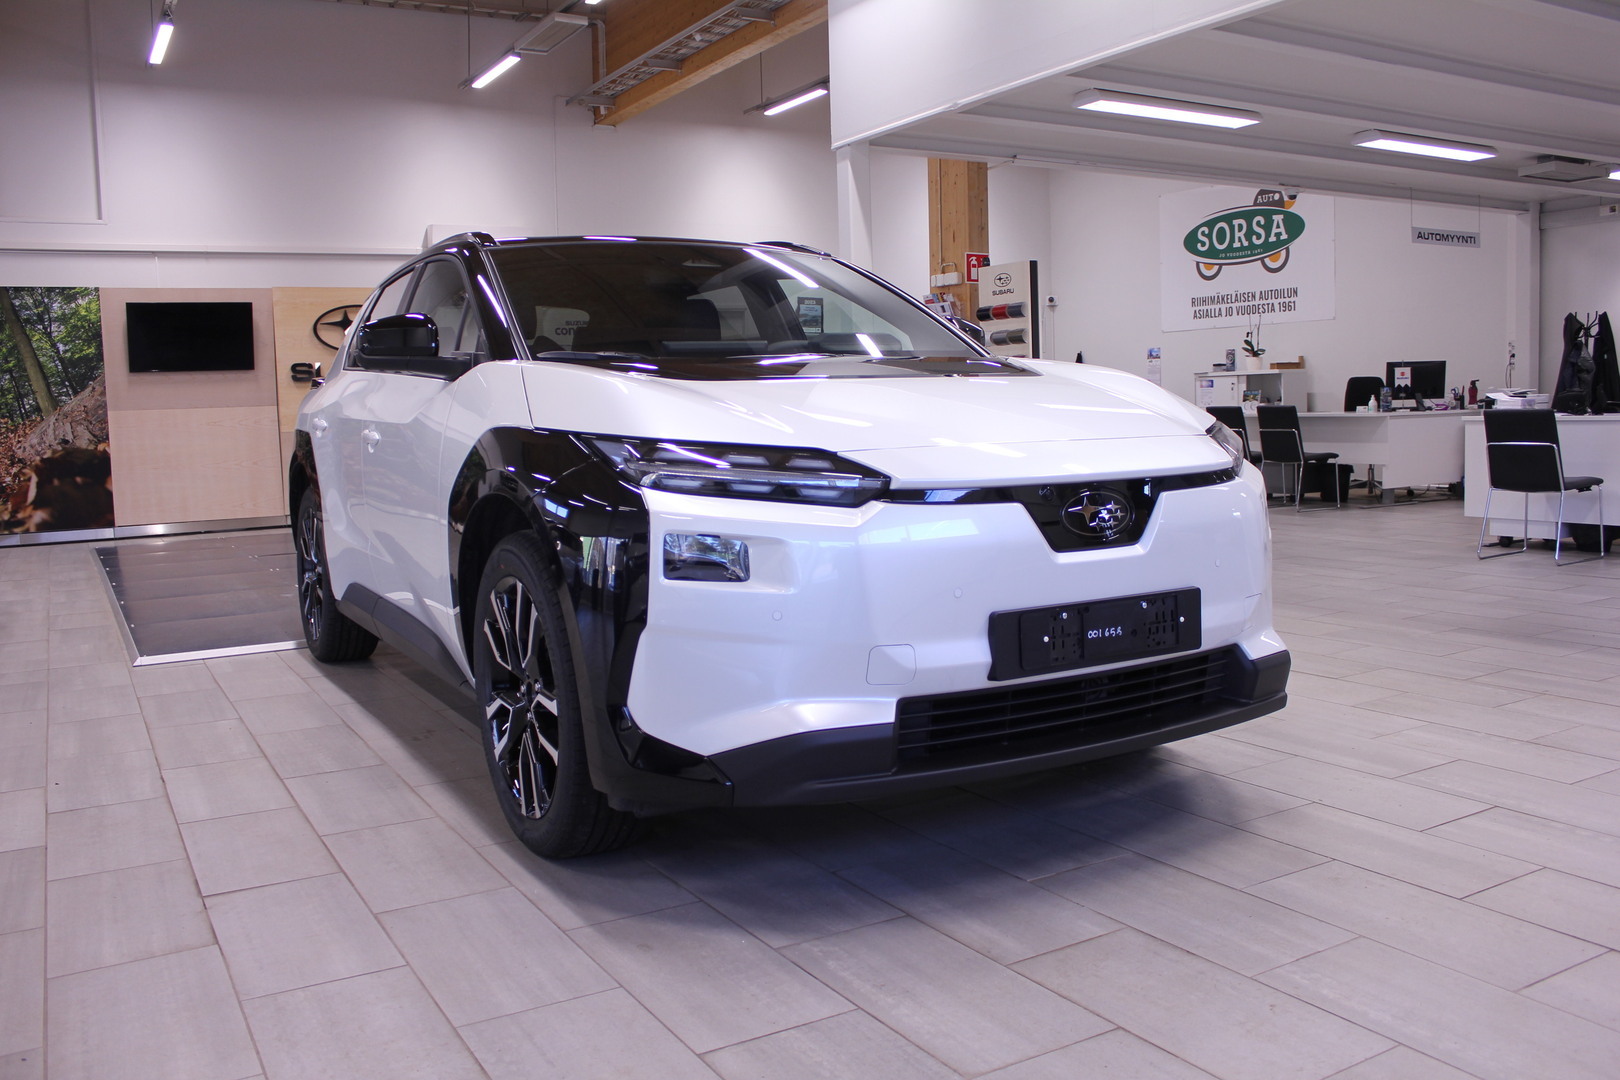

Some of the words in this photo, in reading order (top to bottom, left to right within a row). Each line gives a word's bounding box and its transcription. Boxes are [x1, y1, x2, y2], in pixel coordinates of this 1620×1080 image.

[1257, 192, 1280, 203] AUTO
[1197, 214, 1288, 251] SORSA
[1416, 231, 1476, 244] AUTOMYYNTI
[992, 288, 1015, 296] SUBARU
[1191, 290, 1256, 307] RIIHIMÄKELÄISEN
[1258, 287, 1298, 301] AUTOILUN
[1193, 307, 1223, 320] ASIALLA
[1225, 306, 1234, 317] JO
[1236, 302, 1276, 316] VUODESTA
[1278, 300, 1296, 313] 1961
